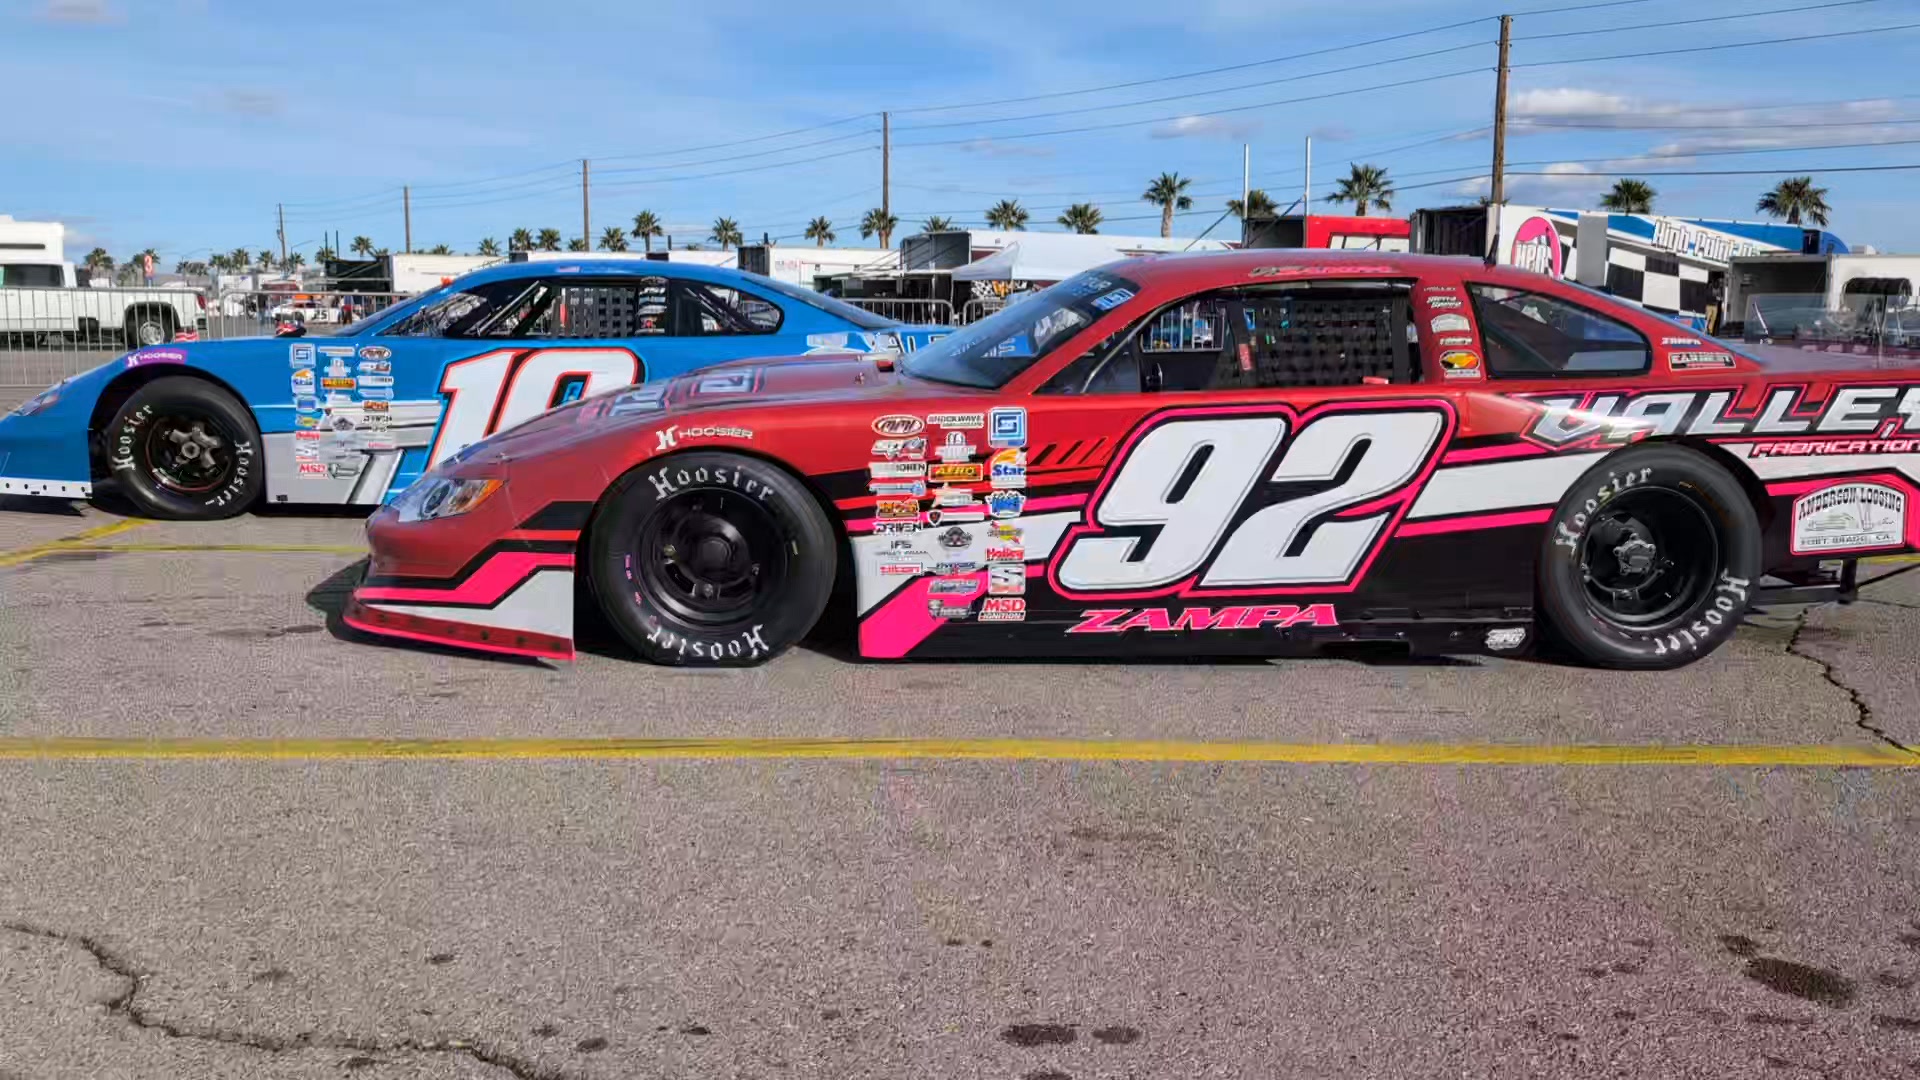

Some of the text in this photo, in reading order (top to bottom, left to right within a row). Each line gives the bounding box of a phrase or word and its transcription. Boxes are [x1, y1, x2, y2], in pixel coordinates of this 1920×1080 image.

[112, 404, 153, 471] Hoosier
[679, 427, 753, 440] HOOSIER
[648, 466, 775, 501] Hoosier
[1054, 405, 1452, 597] 92
[1552, 468, 1652, 556] Hoosier
[1798, 488, 1857, 520] ANDERSON
[985, 599, 1026, 611] MSD
[1065, 604, 1339, 633] ZAMPA
[1655, 568, 1750, 655] Hoosier
[647, 624, 770, 661] Hoosier
